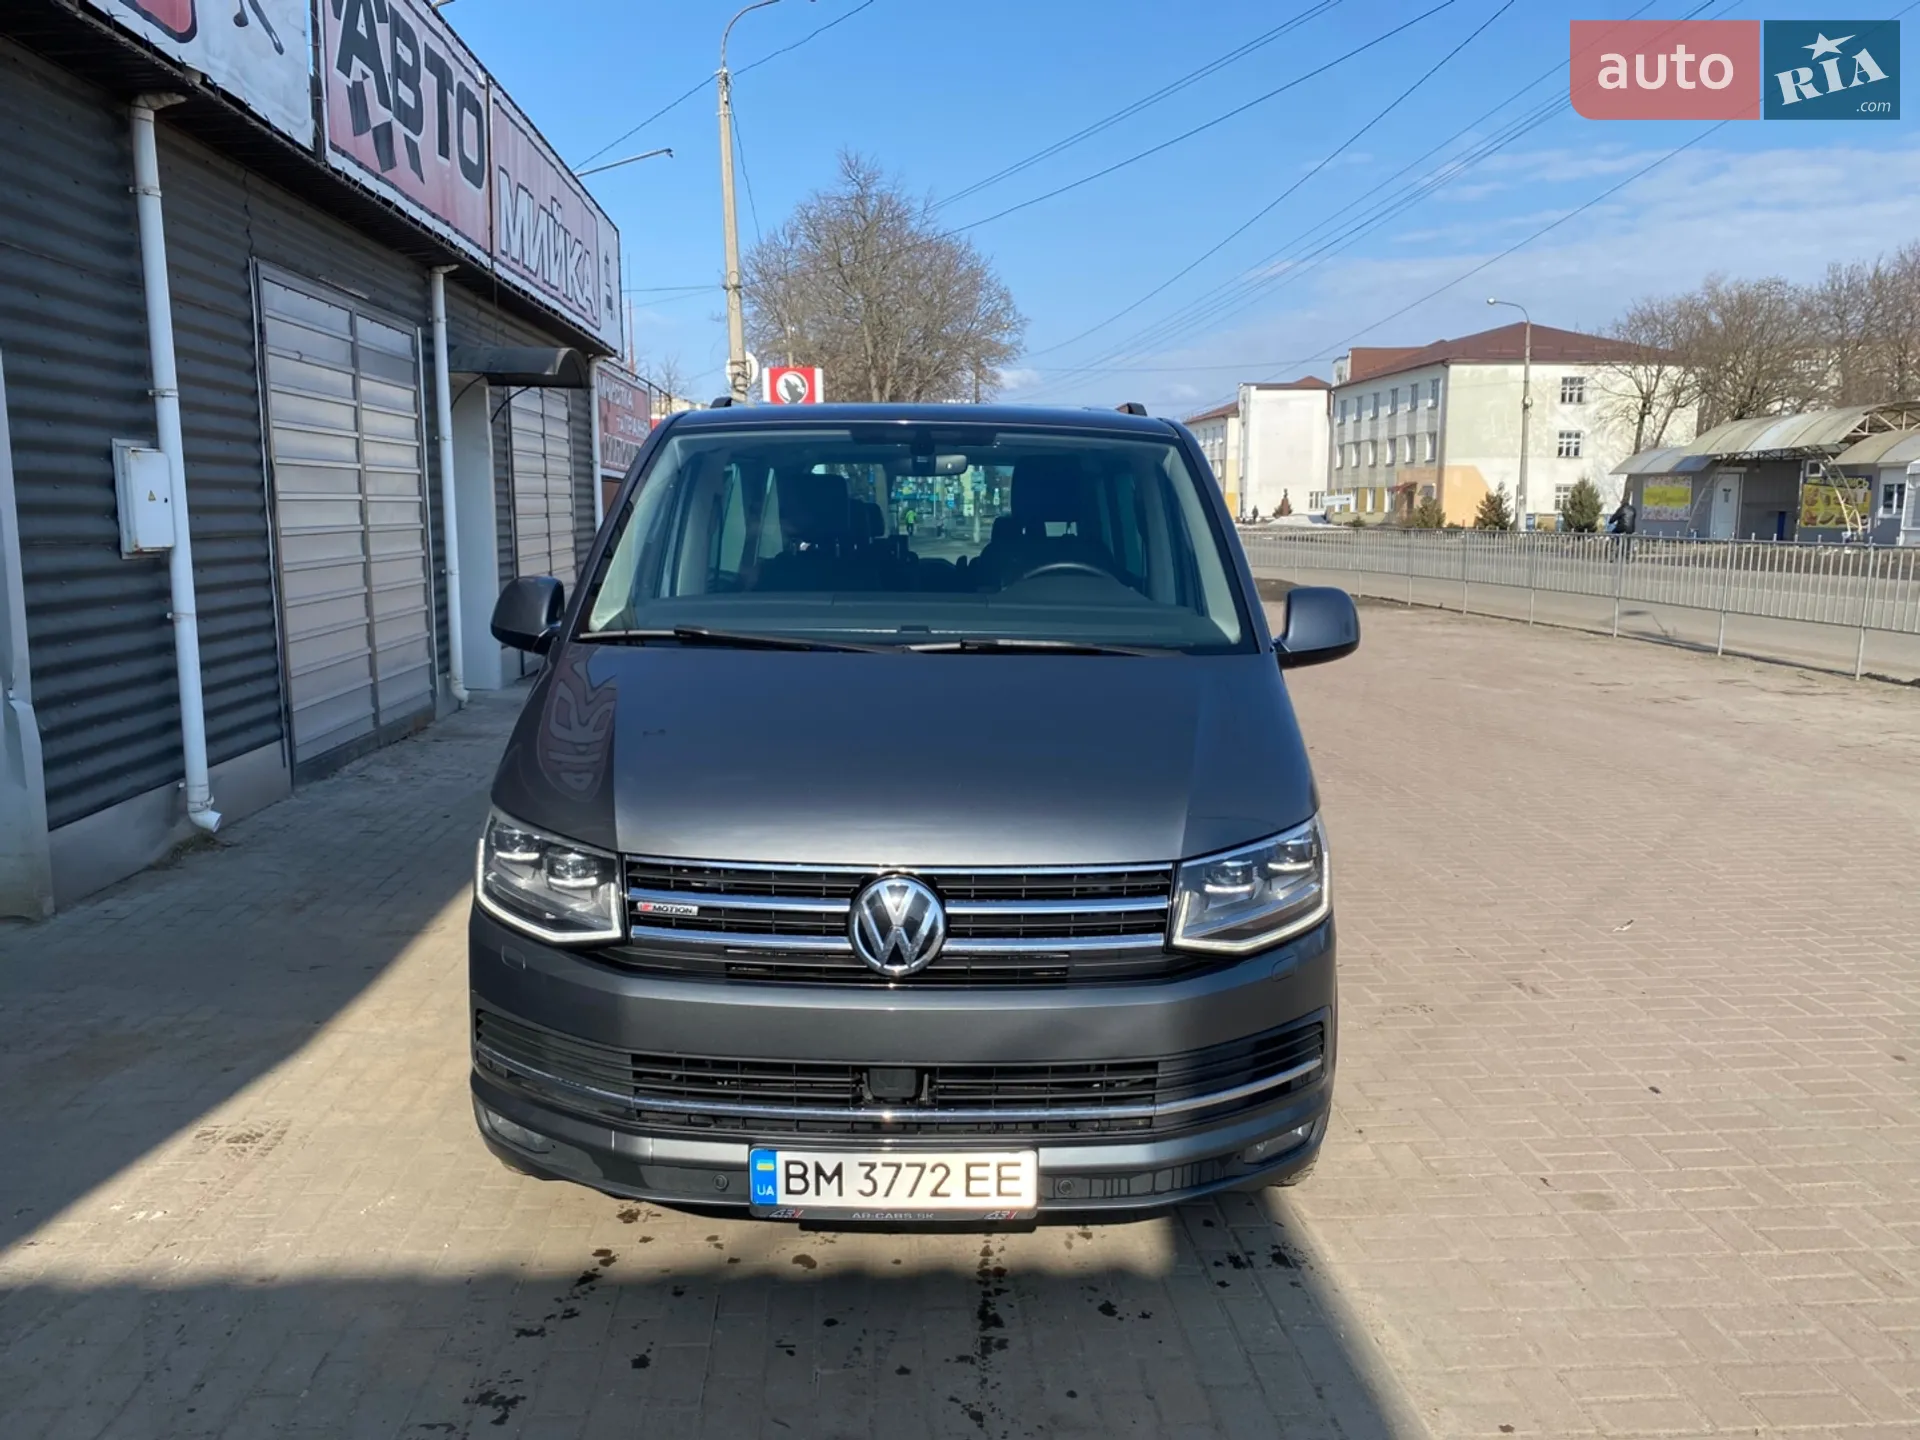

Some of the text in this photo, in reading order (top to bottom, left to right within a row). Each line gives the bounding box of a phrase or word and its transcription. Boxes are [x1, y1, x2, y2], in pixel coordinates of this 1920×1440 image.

[336, 0, 598, 321] АВТО МИЙКА
[757, 1185, 775, 1196] UA
[784, 1160, 1022, 1198] BM 3772 EE
